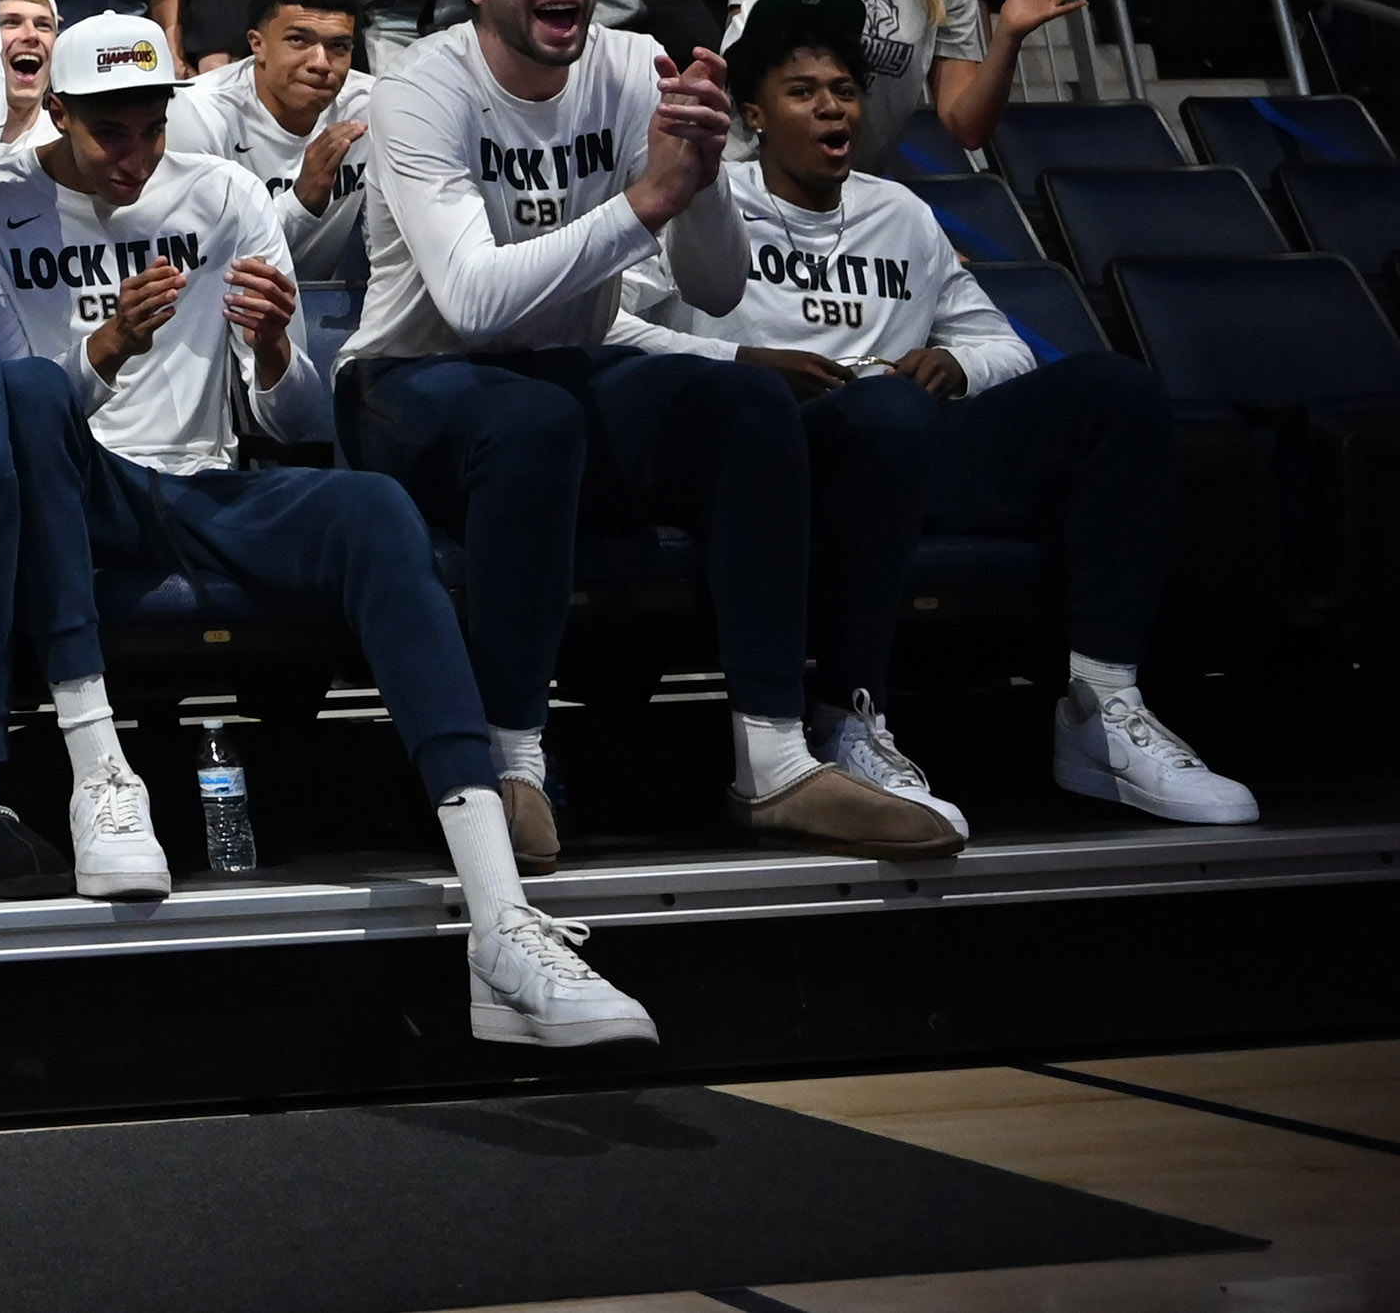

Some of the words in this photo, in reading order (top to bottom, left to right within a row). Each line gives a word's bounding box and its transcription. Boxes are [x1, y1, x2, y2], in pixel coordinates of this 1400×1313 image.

[10, 243, 113, 290] LOCK
[114, 239, 151, 287] IT
[156, 231, 208, 274] IN.
[748, 243, 834, 292] LOCK
[837, 254, 869, 296] IT
[873, 257, 913, 301] IN.
[78, 293, 120, 323] CB
[801, 297, 863, 329] CBU
